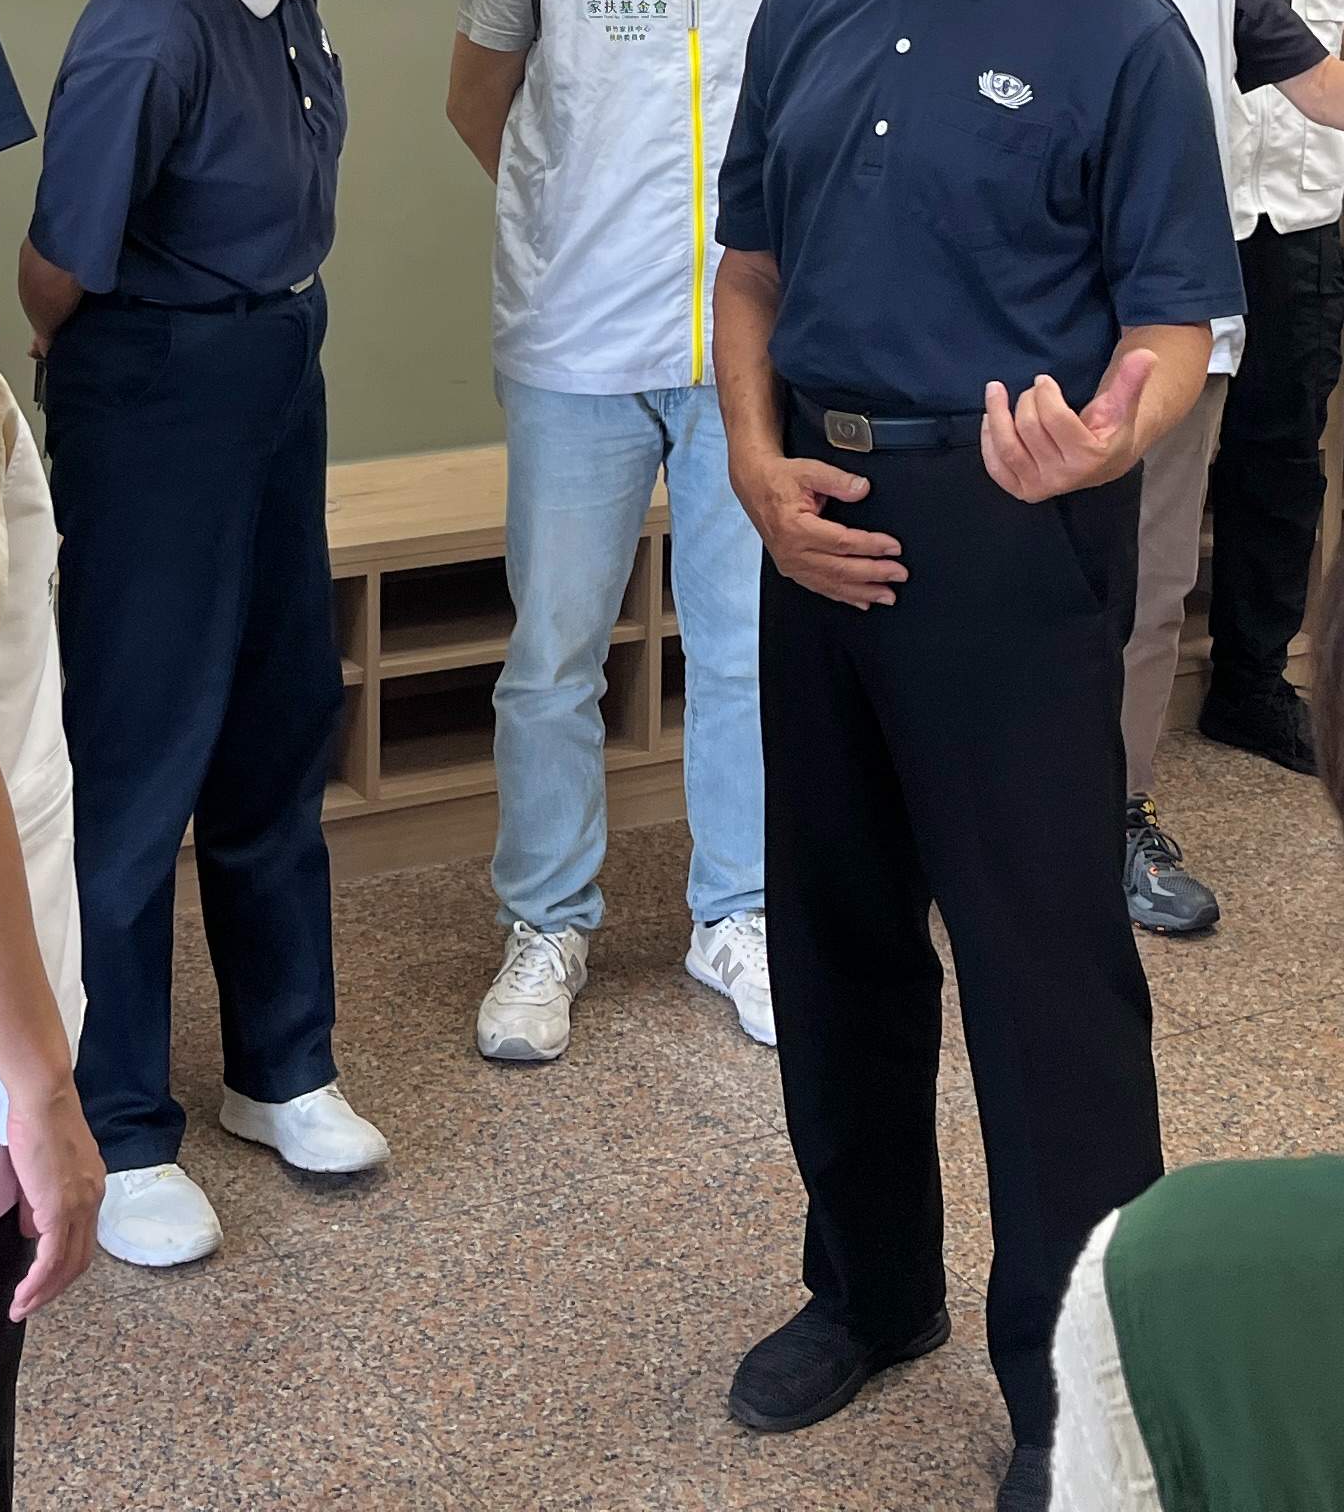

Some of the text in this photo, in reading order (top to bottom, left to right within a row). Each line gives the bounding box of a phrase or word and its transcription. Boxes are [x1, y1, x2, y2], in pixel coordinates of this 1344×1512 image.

[586, 0, 667, 14] 家扶基金會
